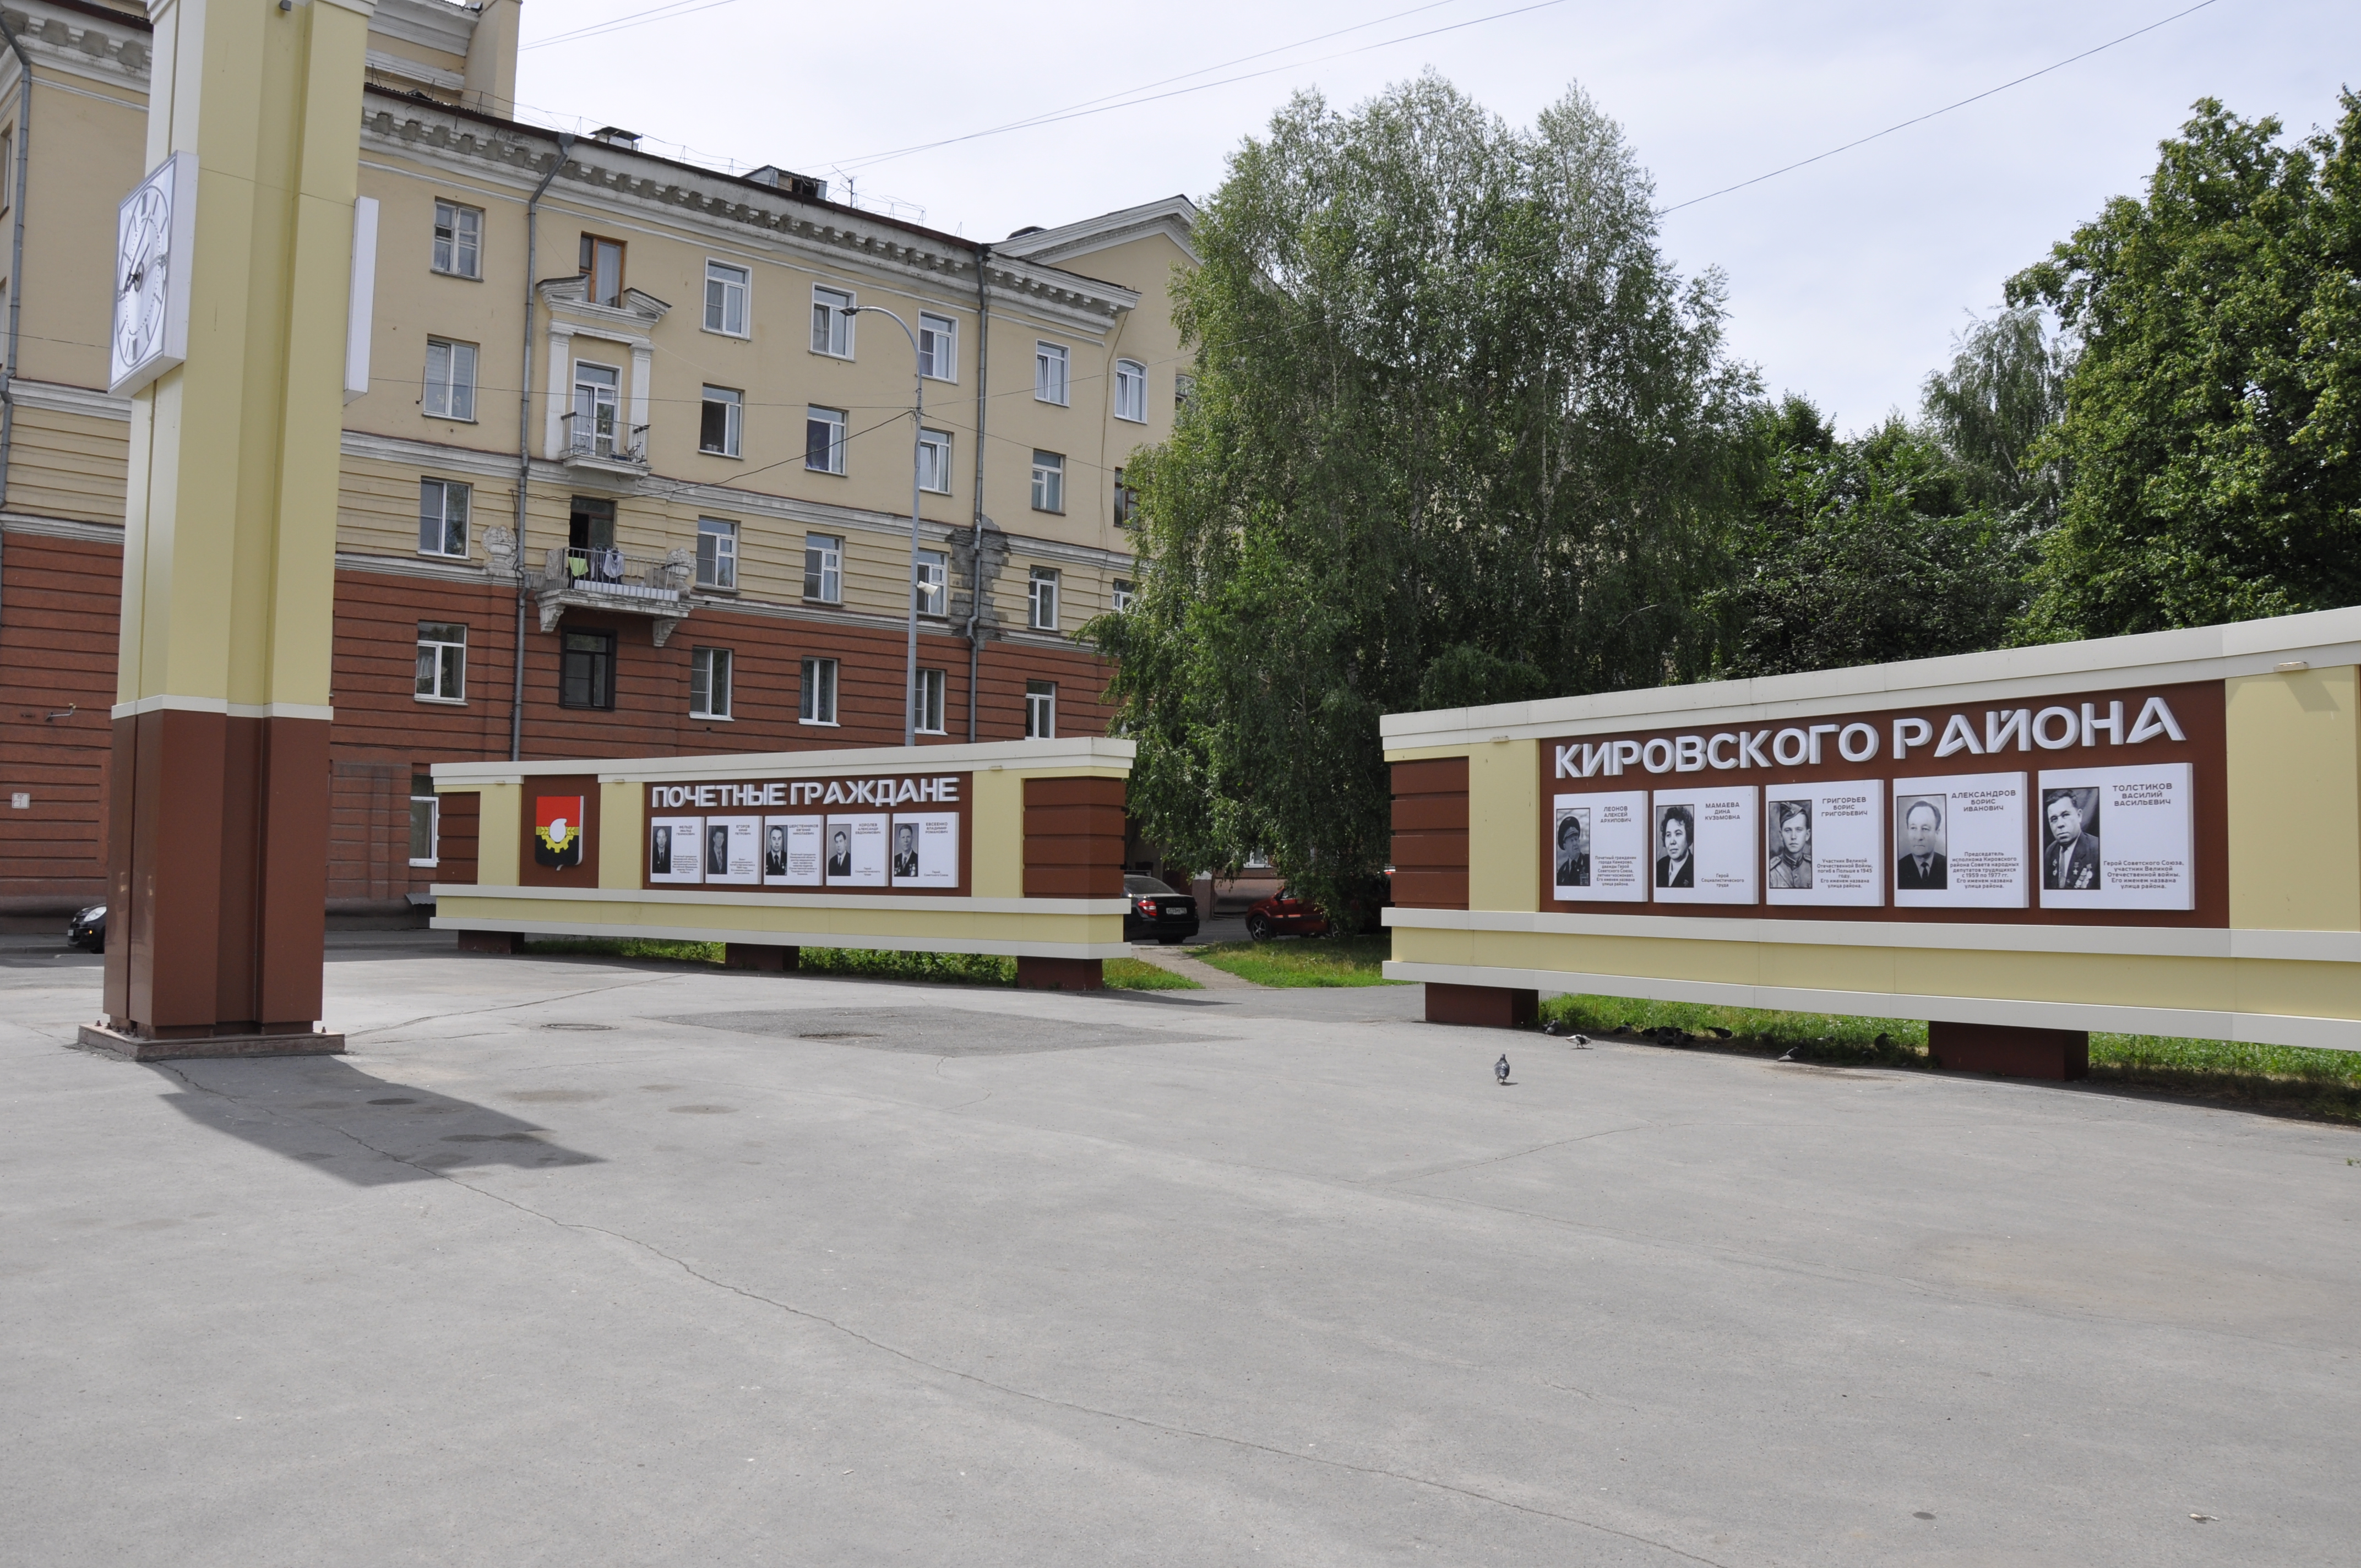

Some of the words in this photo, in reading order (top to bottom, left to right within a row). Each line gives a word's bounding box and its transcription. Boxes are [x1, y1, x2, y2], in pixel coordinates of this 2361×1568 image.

[1555, 723, 1879, 778] КИРОВСКОГО
[1893, 696, 2186, 759] РАЙОНА
[2113, 783, 2172, 792] ТОЛСТИКОВ
[652, 783, 787, 808] ПОЧЕТНЫЕ
[790, 777, 960, 807] ГРАЖДАНЕ
[1951, 790, 2016, 798] АЛЕКСАНДРОВ
[2122, 791, 2162, 799] ВАСИЛИЙ
